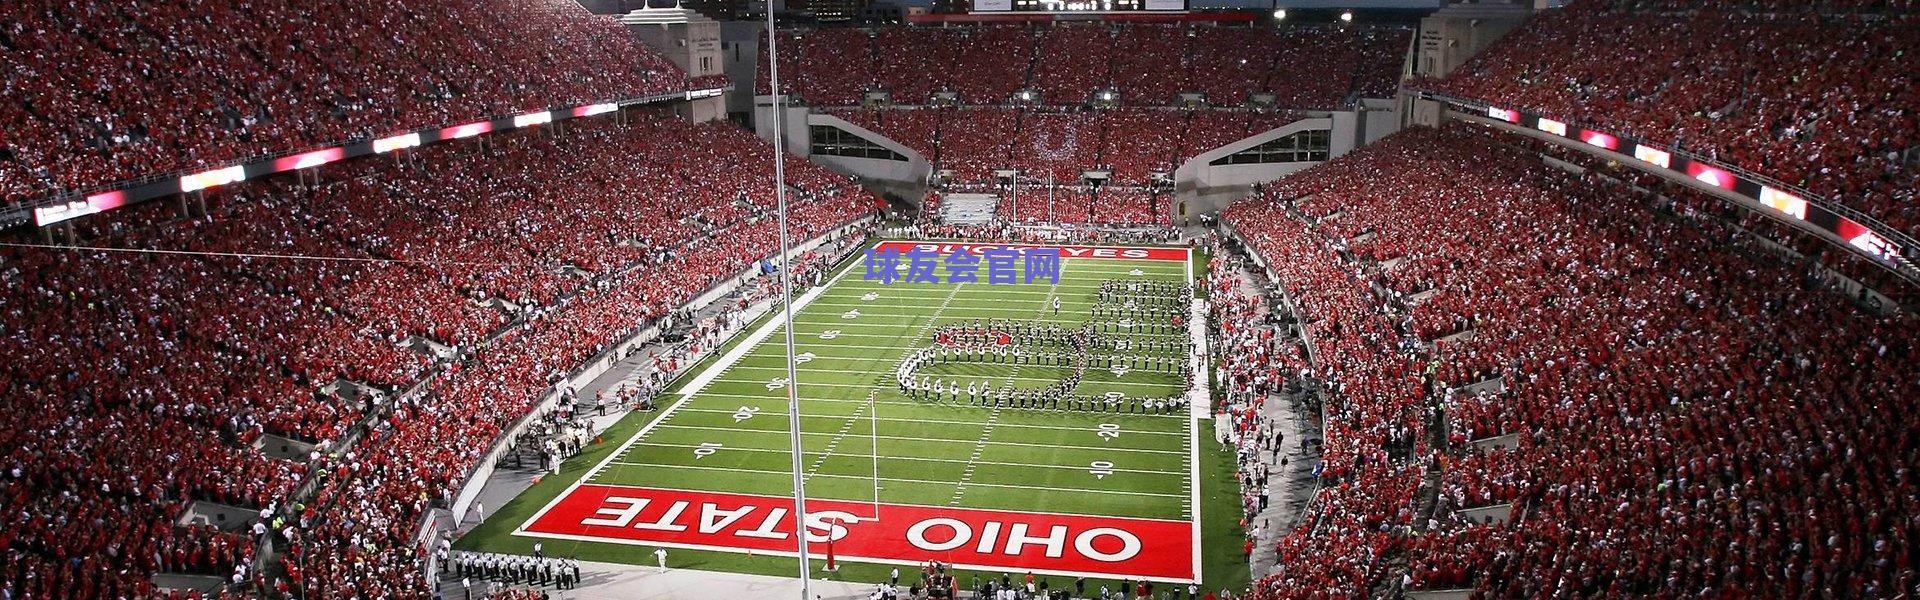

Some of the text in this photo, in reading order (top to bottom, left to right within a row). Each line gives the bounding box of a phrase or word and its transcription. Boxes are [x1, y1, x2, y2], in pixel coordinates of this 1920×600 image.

[911, 244, 1150, 258] BUCKYES
[733, 405, 760, 419] 20
[1097, 423, 1120, 438] 20
[693, 442, 723, 455] 10
[1089, 461, 1114, 475] 10
[580, 496, 1142, 562] OHIO STATE
